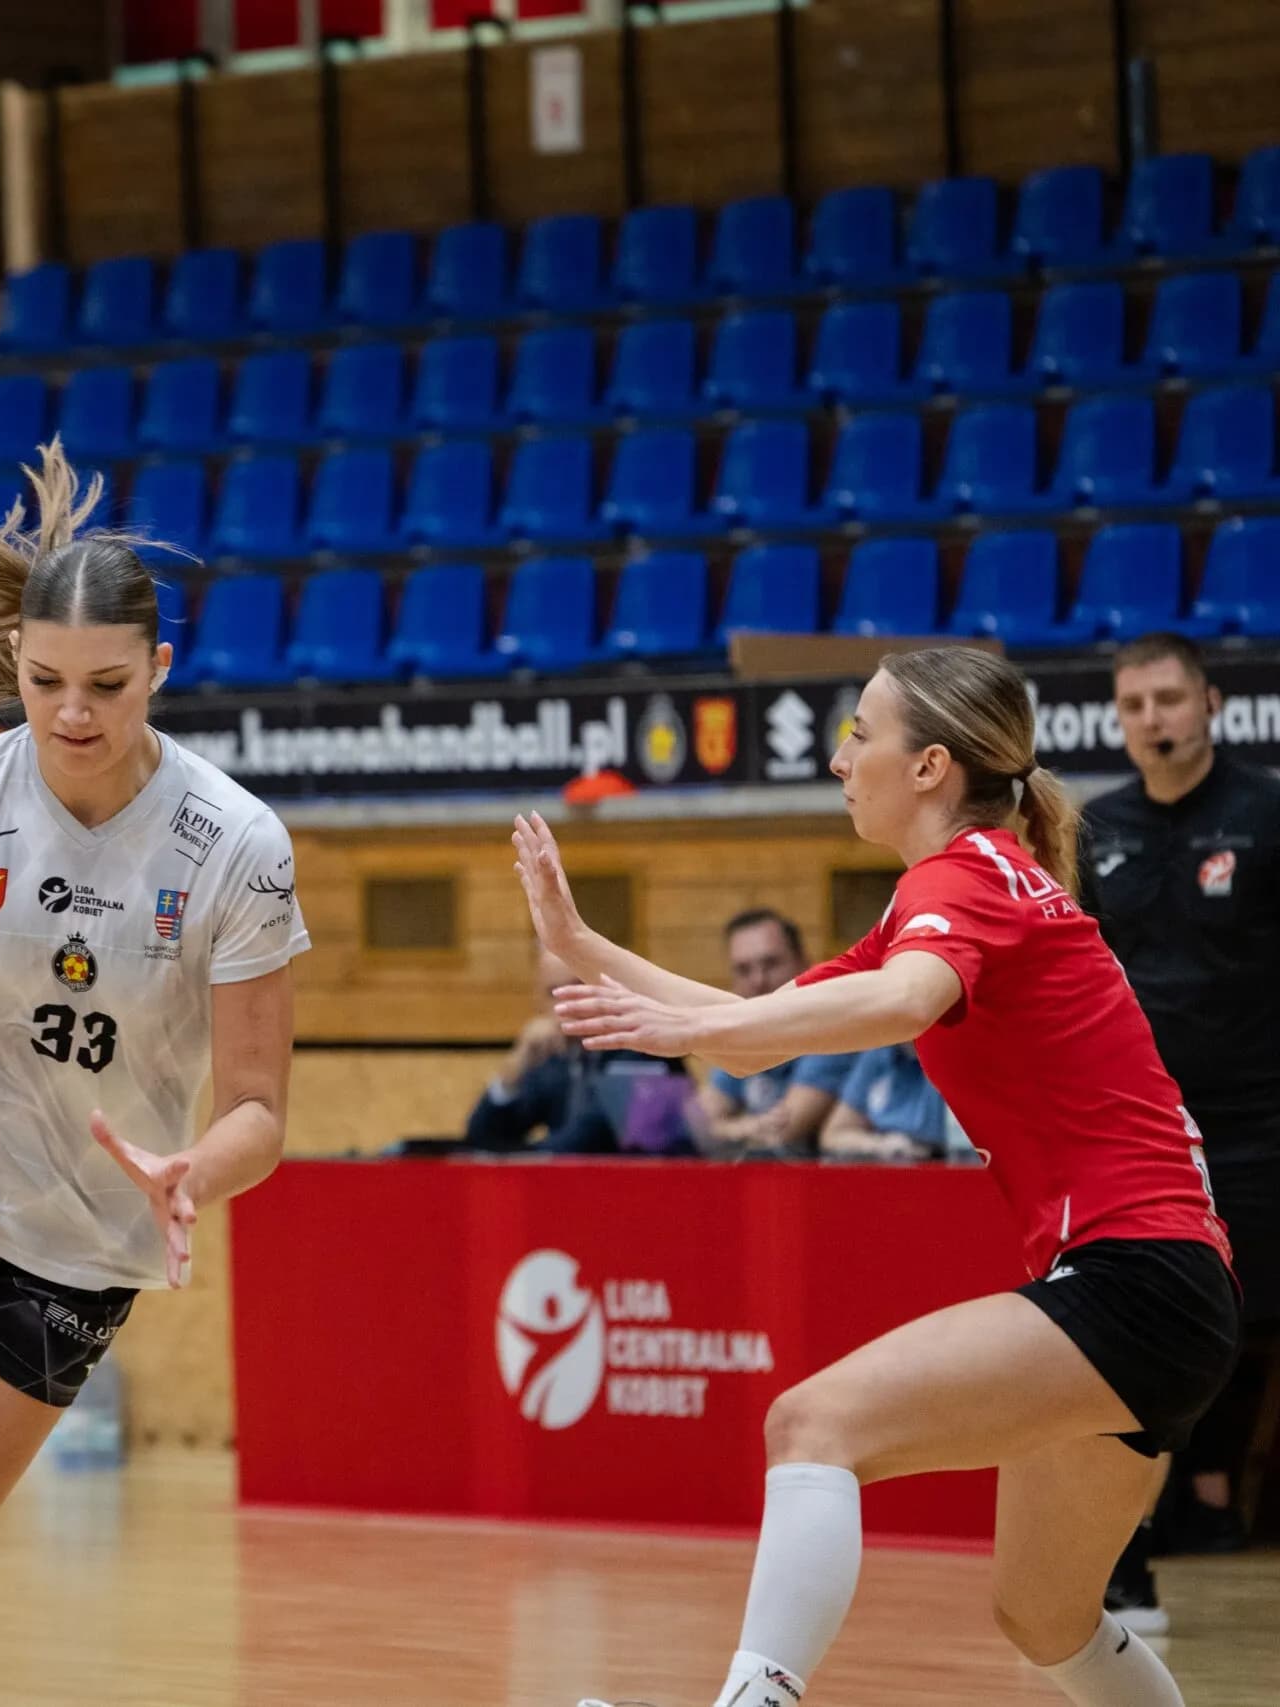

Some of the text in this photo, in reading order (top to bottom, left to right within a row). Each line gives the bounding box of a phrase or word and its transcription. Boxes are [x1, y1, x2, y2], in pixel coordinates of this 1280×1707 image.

[73, 904, 104, 918] KOBIET
[74, 896, 125, 911] CENTRALNA
[75, 885, 95, 896] LIGA
[30, 1003, 118, 1074] 33
[604, 1280, 671, 1321] LIGA
[608, 1327, 774, 1373] CENTRALNA
[608, 1374, 709, 1417] KOBIET
